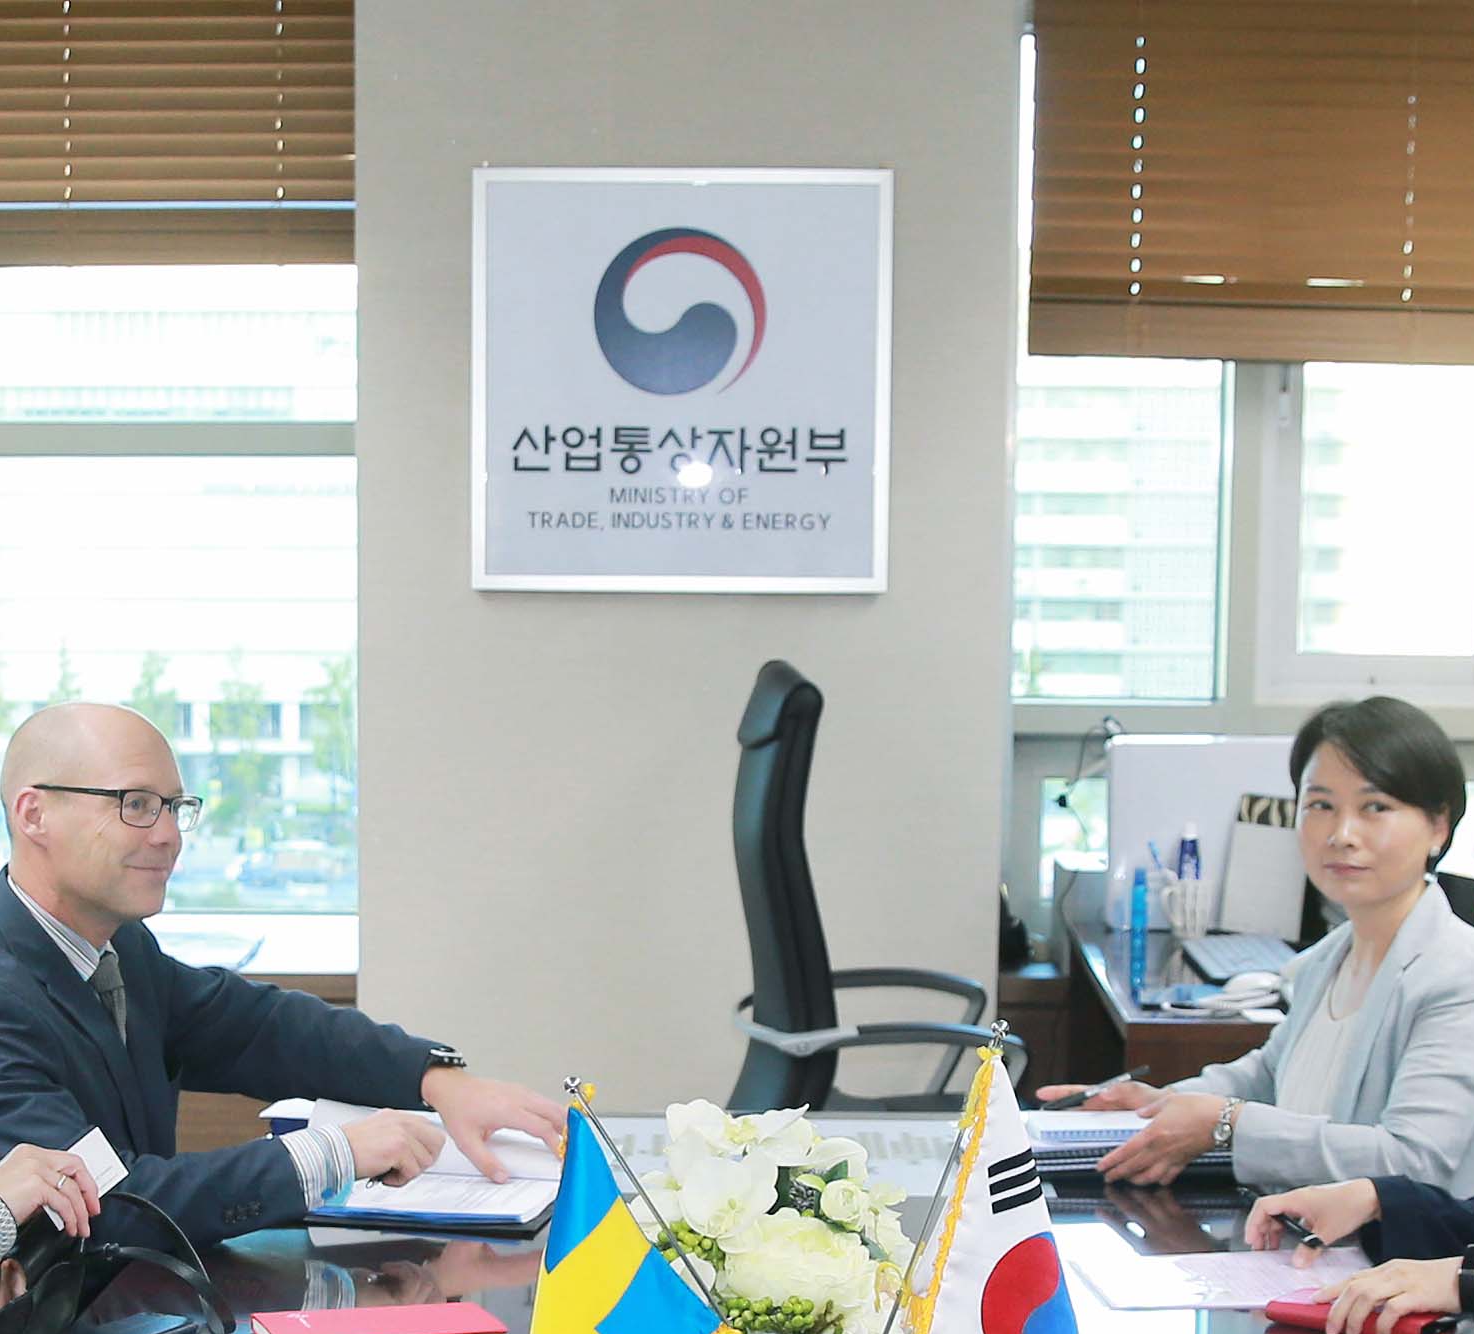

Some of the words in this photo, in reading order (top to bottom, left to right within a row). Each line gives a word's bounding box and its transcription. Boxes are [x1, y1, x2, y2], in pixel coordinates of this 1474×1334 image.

[512, 424, 848, 475] 산업통상자원부
[609, 487, 710, 505] MINISTRY
[719, 487, 749, 505] OF
[528, 511, 605, 531] TRADE,
[612, 511, 714, 530] INDUSTRY
[721, 512, 735, 530] &
[743, 512, 832, 531] ENERGY
